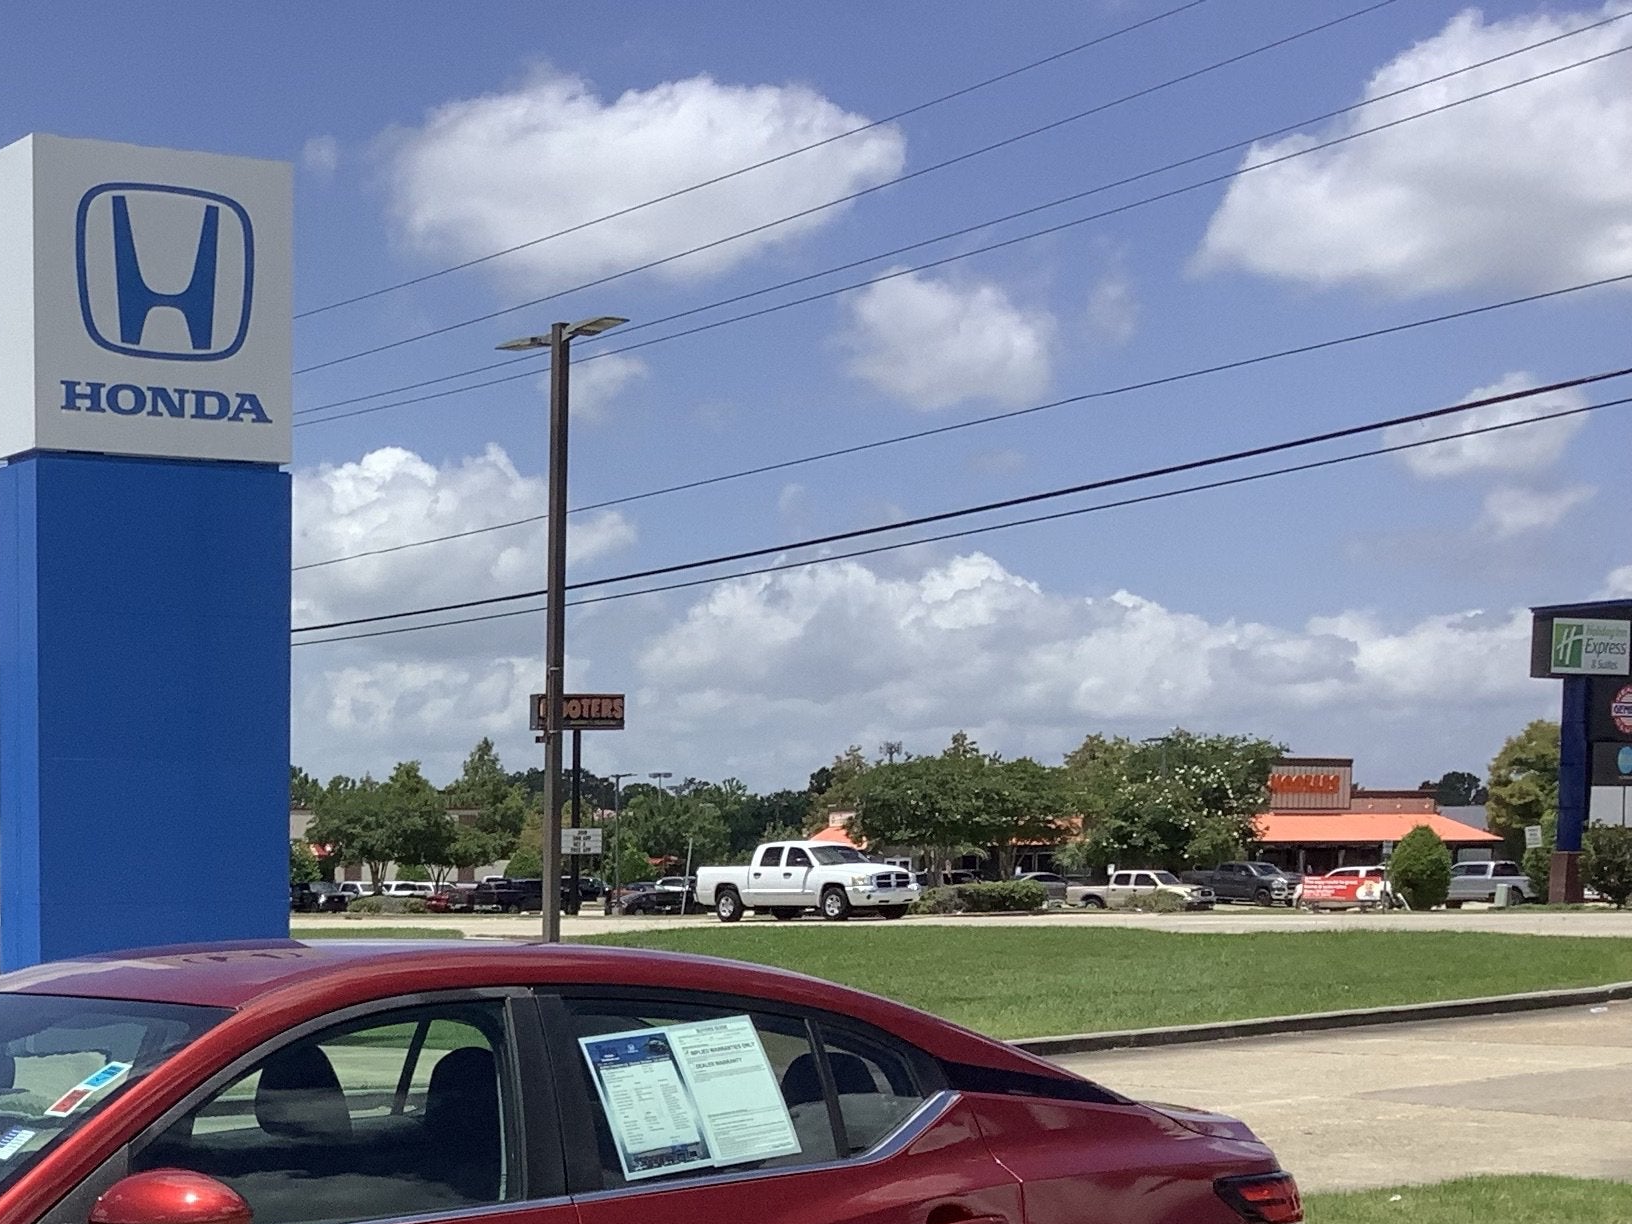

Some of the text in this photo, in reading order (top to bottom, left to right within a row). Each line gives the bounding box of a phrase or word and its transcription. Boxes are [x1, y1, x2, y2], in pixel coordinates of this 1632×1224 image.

[60, 380, 273, 424] HONDA
[1585, 638, 1626, 658] Express
[1598, 660, 1618, 670] Suites
[539, 698, 623, 719] OTERS
